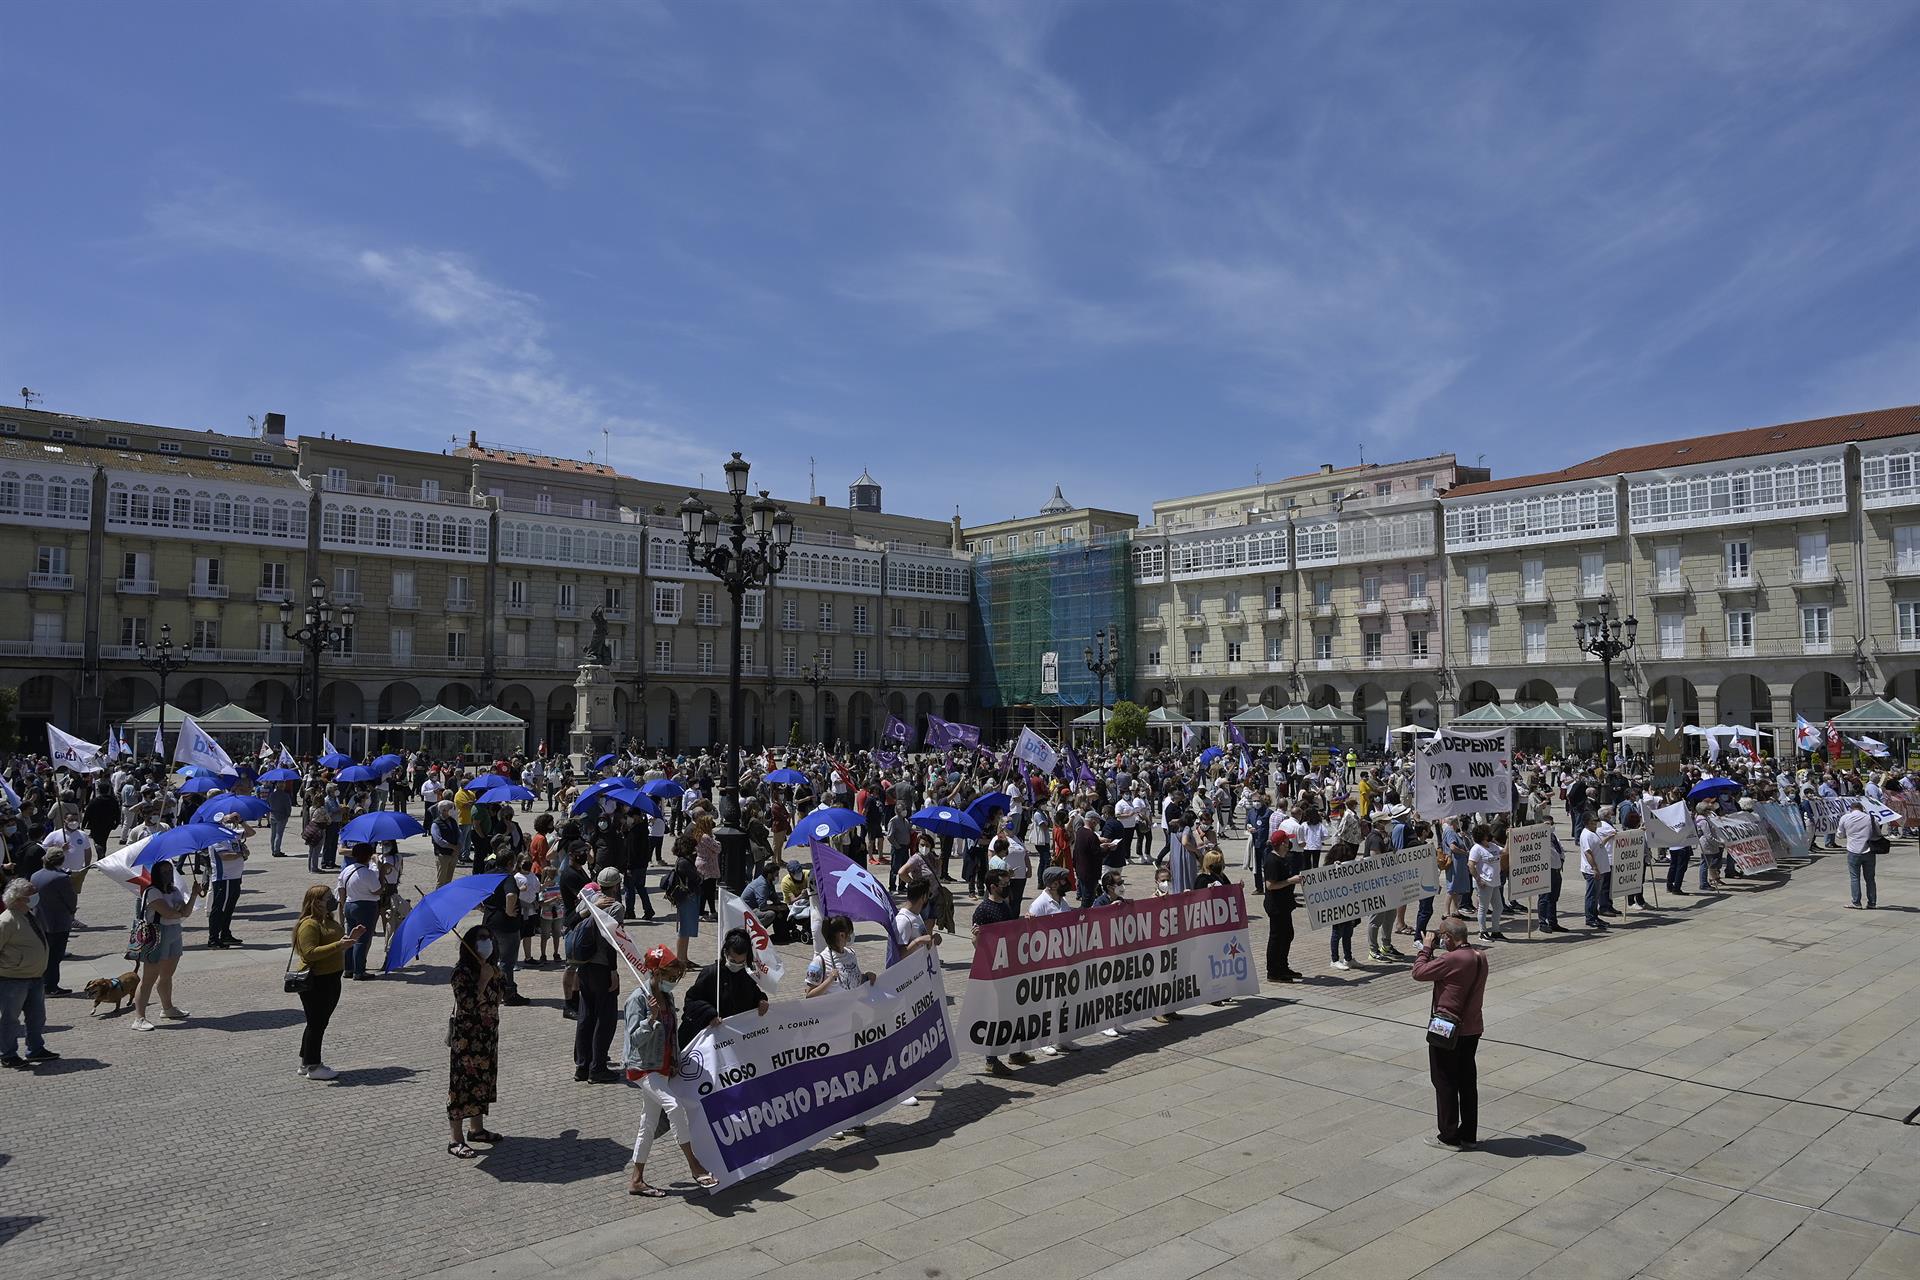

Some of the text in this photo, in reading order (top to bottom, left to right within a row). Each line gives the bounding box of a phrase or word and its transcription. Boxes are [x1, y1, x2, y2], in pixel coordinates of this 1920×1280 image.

[1024, 738, 1049, 762] bng
[1443, 736, 1505, 752] DEPENDE
[1468, 762, 1494, 778] NON
[1815, 817, 1828, 832] AS
[1513, 830, 1548, 843] NOVO CHUAC
[1615, 836, 1644, 849] NON MAIS
[1520, 842, 1542, 853] PARA OS
[1620, 849, 1638, 861] OBRAS
[1302, 873, 1317, 886] POR
[1317, 872, 1328, 883] UN
[1328, 859, 1380, 880] FERROCARRIL
[1408, 851, 1412, 861] E
[1512, 863, 1549, 877] GRATUITOS DO
[1615, 863, 1625, 873] NO
[1521, 875, 1540, 886] PORTO
[1619, 873, 1638, 885] CHUAC
[1361, 895, 1387, 912] TREN
[992, 896, 1240, 971] A CORUÑA NON SE VENDE
[1208, 954, 1247, 981] bng
[1016, 947, 1178, 1005] OUTRO MODELO DE
[970, 971, 1200, 1047] CIDADE É IMPRESCINDÍBEL
[713, 1038, 734, 1051] UNIDAS
[742, 1026, 769, 1042] PODEMOS
[787, 1017, 820, 1030] CORUÑA
[698, 990, 935, 1096] O NOSO FUTURO NON SE VENDE
[813, 1062, 879, 1107] PARA
[882, 1055, 897, 1081] A
[899, 1017, 946, 1069] CIDADE
